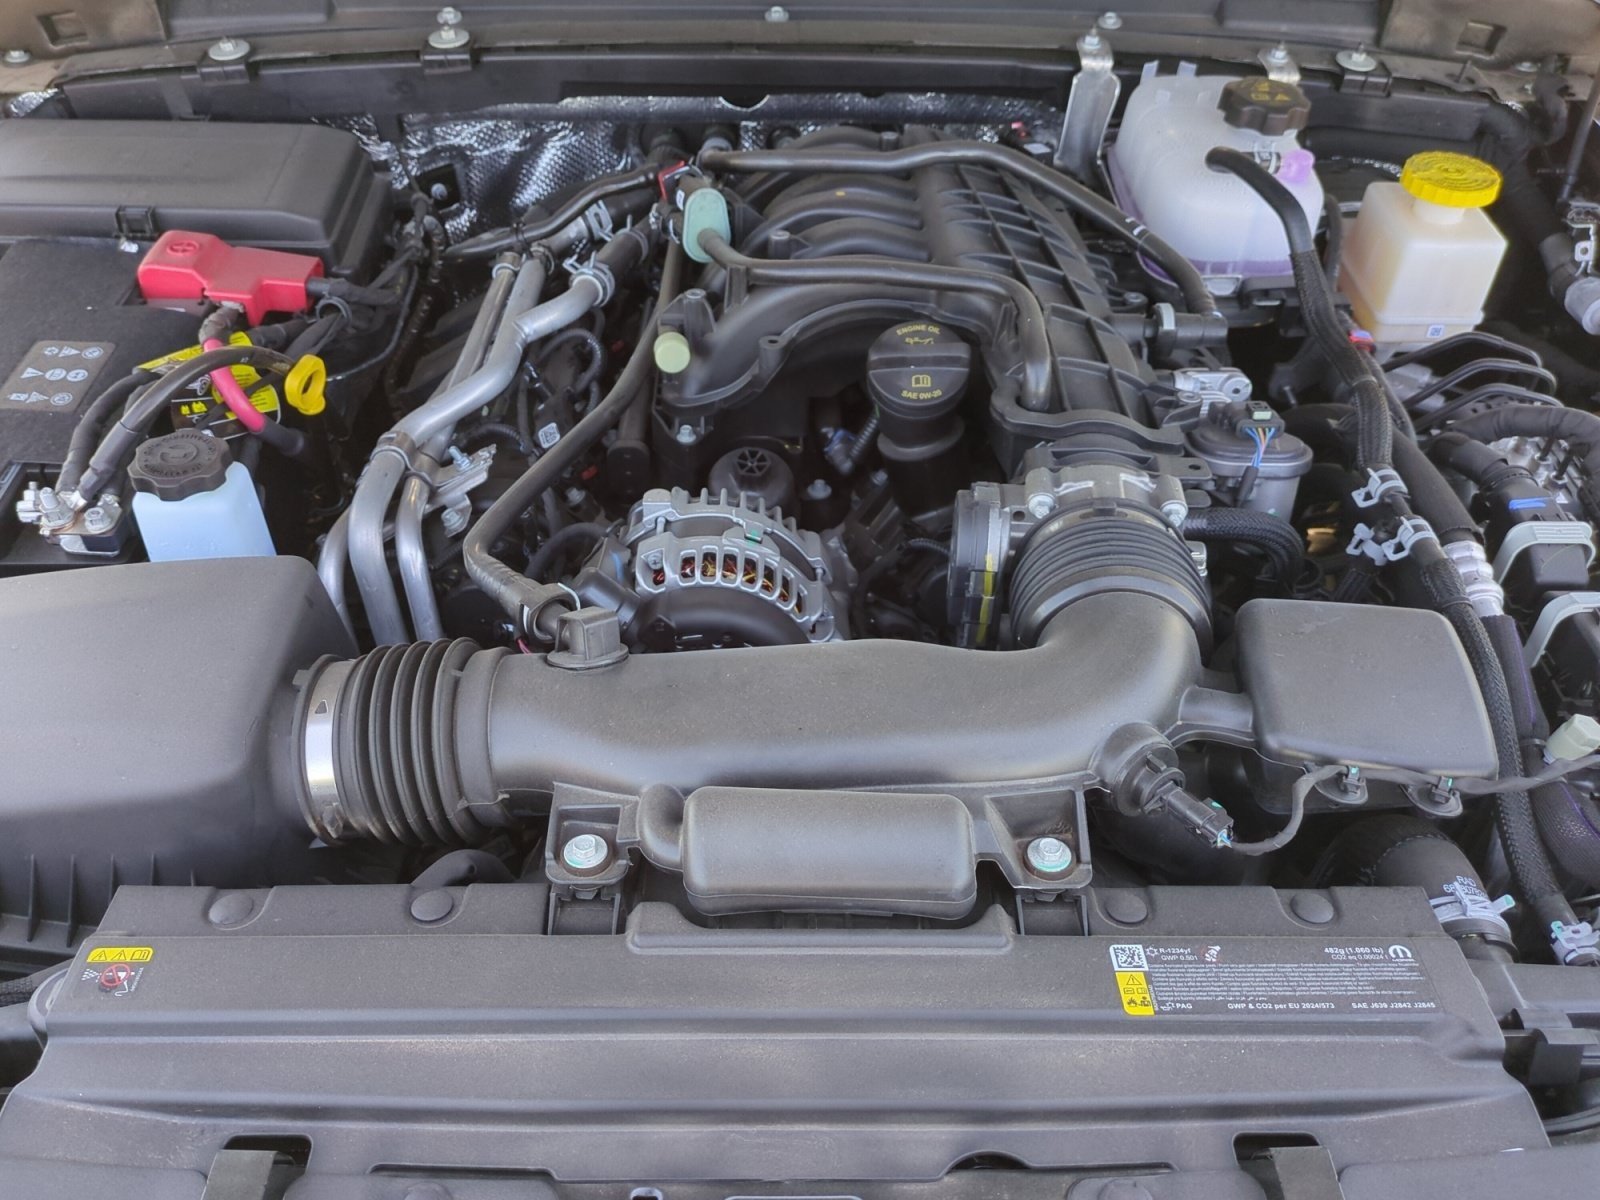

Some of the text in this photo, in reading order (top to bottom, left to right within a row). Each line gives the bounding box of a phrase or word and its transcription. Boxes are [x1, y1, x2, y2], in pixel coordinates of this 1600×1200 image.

[896, 324, 941, 335] ENGINE OIL
[901, 389, 943, 400] SAE 0W-20
[1456, 875, 1477, 886] RAD
[1324, 947, 1345, 955] 482g
